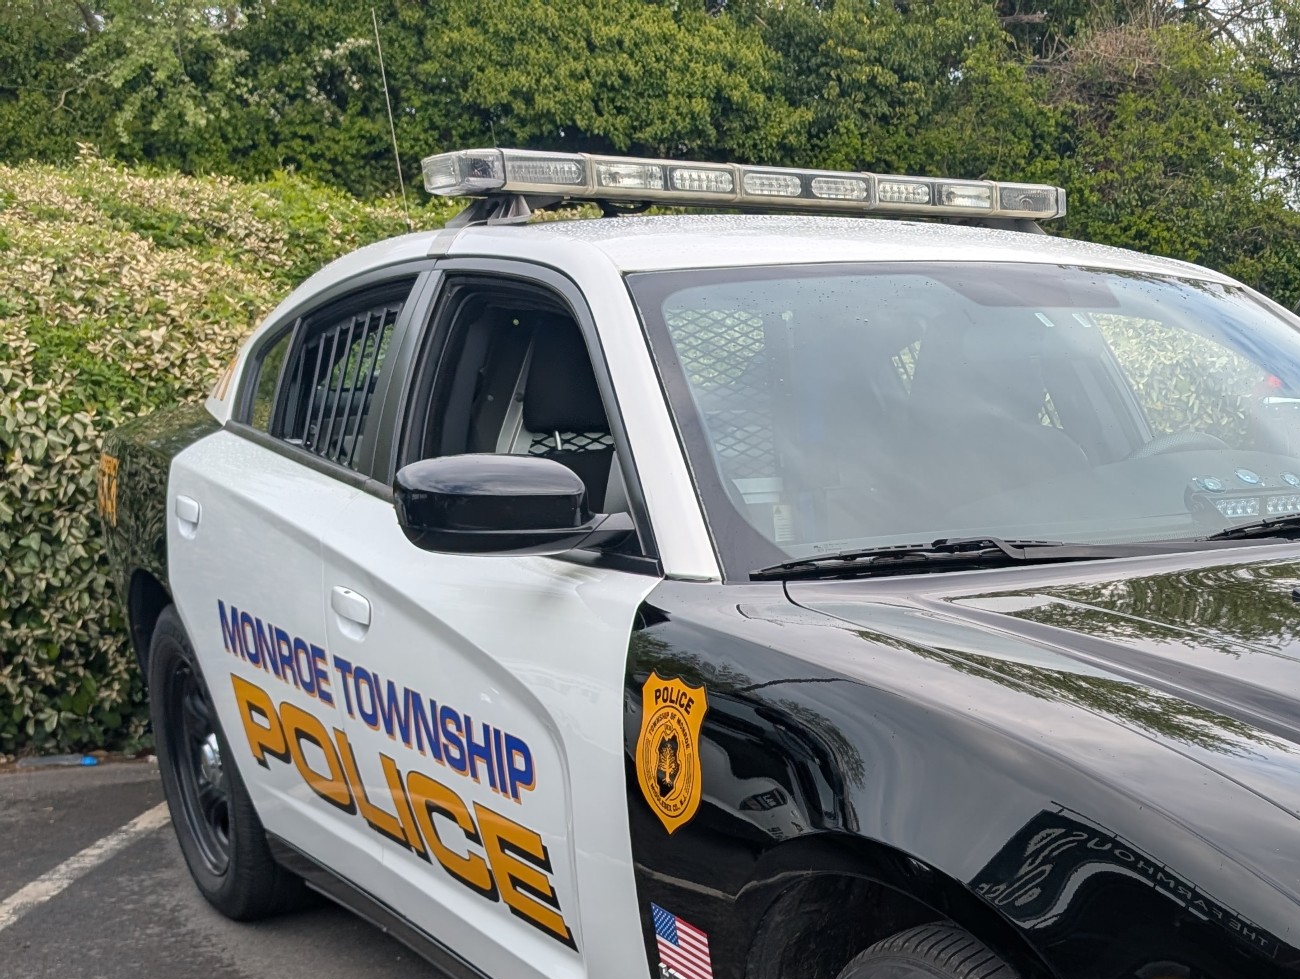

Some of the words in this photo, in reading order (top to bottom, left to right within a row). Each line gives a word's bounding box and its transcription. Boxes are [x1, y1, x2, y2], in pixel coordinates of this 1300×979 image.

[217, 599, 336, 707] MONROE
[333, 655, 537, 806] TOWNSHIP
[654, 686, 695, 715] POLICE
[230, 672, 580, 953] POLICE
